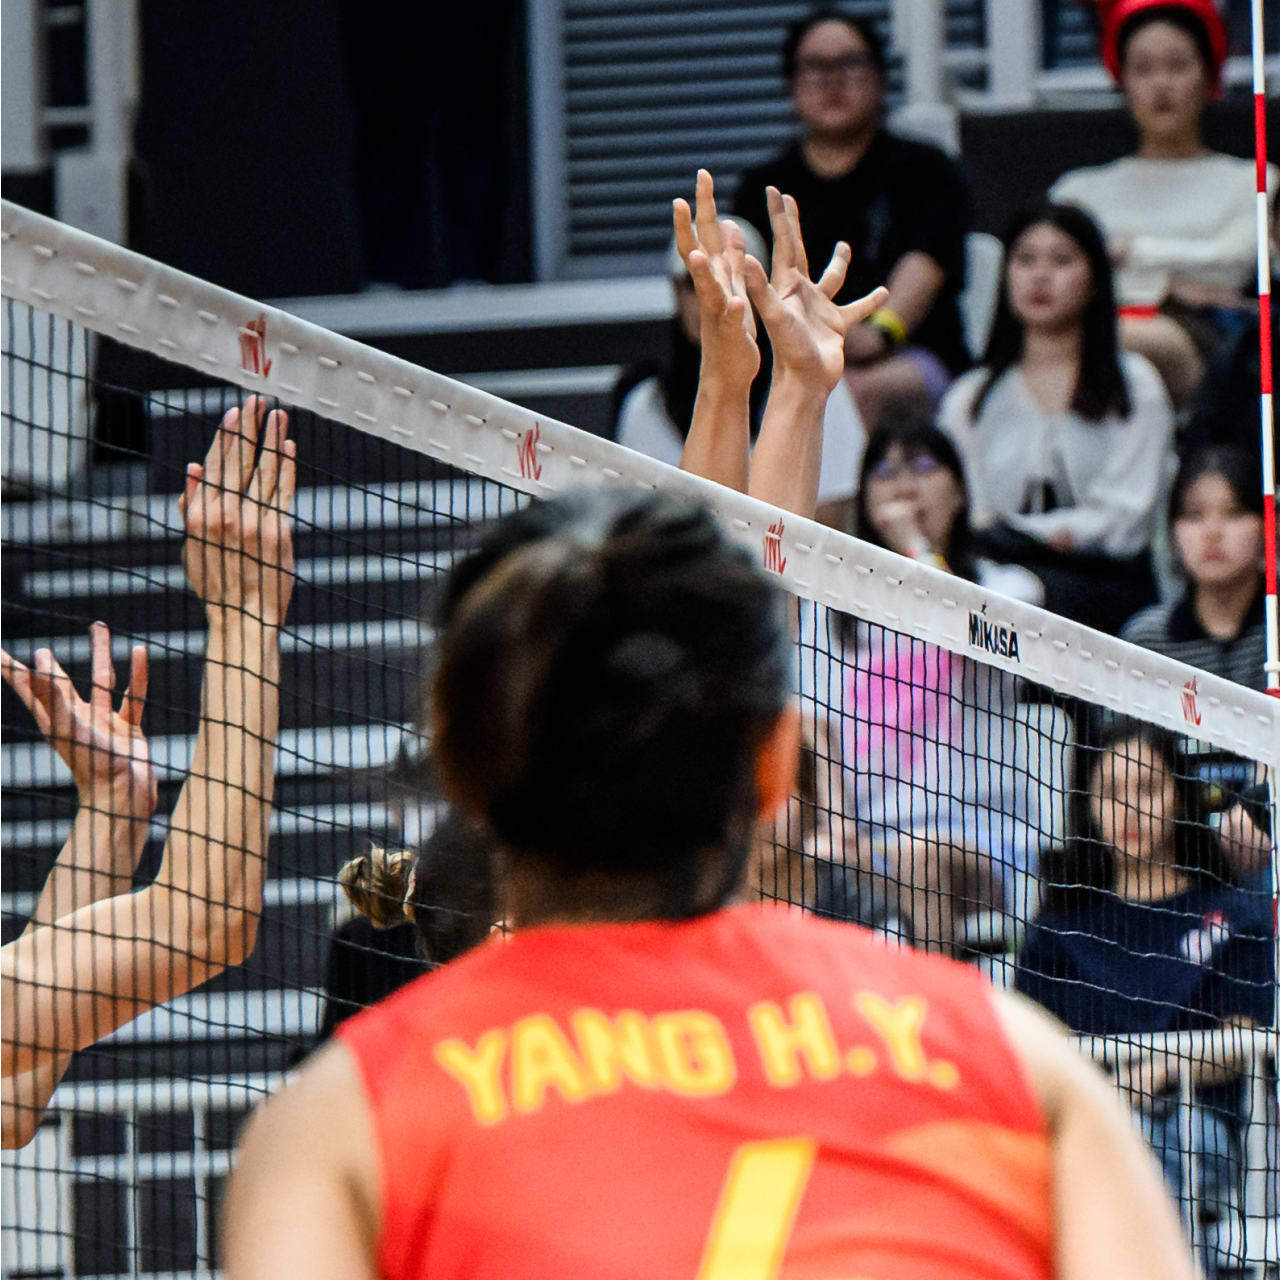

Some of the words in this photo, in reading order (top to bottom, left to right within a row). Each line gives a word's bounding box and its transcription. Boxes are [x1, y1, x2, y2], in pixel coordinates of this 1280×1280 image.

[967, 609, 1021, 663] MIKASA
[434, 1007, 738, 1127] YANG
[748, 992, 961, 1091] H.Y.
